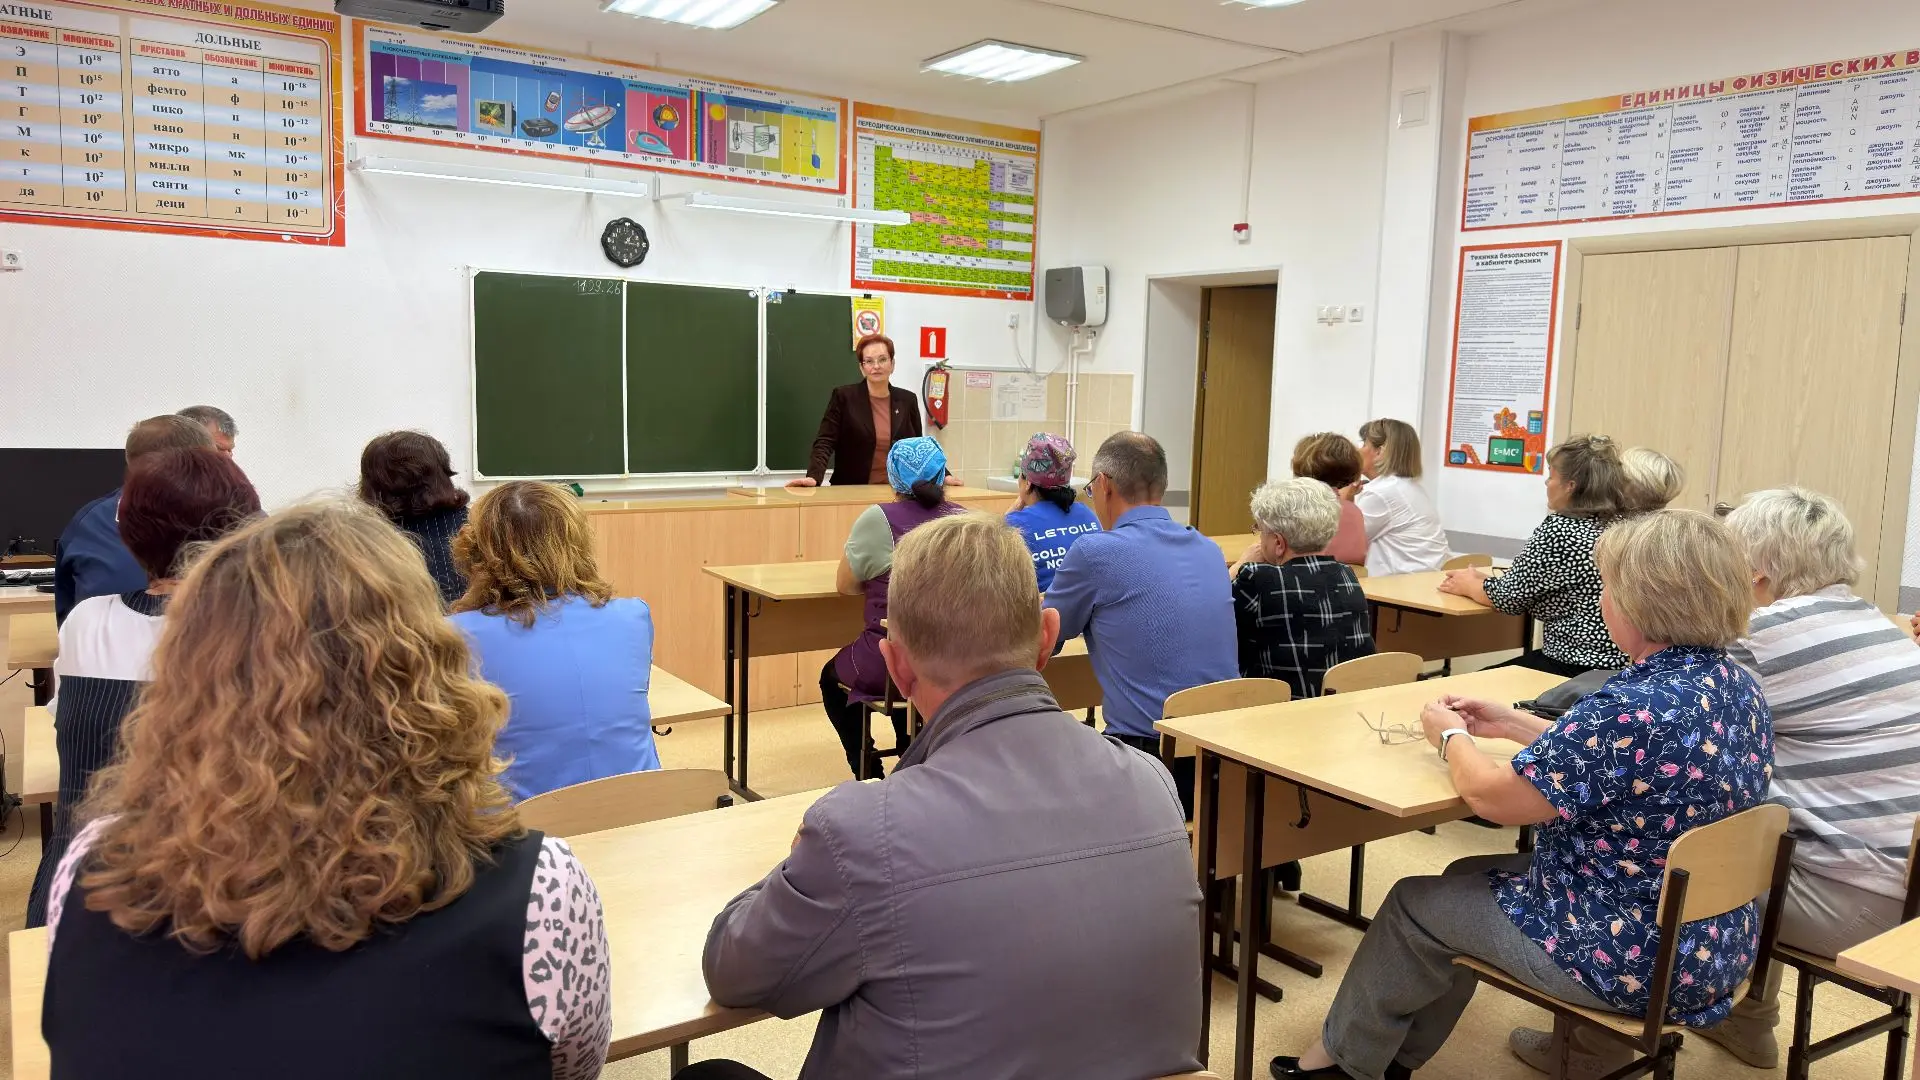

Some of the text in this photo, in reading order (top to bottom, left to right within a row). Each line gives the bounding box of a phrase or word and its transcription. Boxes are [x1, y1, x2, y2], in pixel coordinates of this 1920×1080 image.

[0, 4, 53, 20] АТНЫЕ
[224, 4, 231, 15] И
[235, 6, 290, 25] ДОЛЬНЫХ
[292, 16, 334, 33] ЕДИНИЦ
[0, 25, 50, 39] ОЗНАЧЕНИЕ
[63, 33, 114, 48] МНОЖИТЕЛЬ
[195, 32, 262, 50] ДОЛЬНЫЕ
[16, 46, 26, 57] Э
[204, 54, 258, 68] ОБОЗНАЧЕНИЕ
[15, 66, 27, 77] П
[152, 66, 181, 77] атто
[268, 62, 314, 76] МНОЖИТЕЛЬ
[1621, 81, 1725, 108] ЕДИНИЦЫ
[1732, 53, 1897, 91] ФИЗИЧЕСКИХ
[17, 86, 28, 97] Т
[147, 83, 187, 98] фемто
[1879, 93, 1906, 101] джоуль
[18, 106, 29, 117] Г
[152, 104, 184, 116] пико
[1579, 119, 1623, 129] ПРОИЗВОДНЫЕ
[1625, 114, 1655, 123] ЕДИНИЦЫ
[1736, 116, 1770, 124] килограмм
[17, 126, 32, 138] М
[153, 123, 184, 135] нано
[905, 128, 930, 136] СИСТЕМА
[931, 131, 964, 142] ХИМИЧЕСКИХ
[966, 136, 994, 146] ЭЛЕМЕНТОВ
[1005, 142, 1036, 151] МЕНДЕЛЕЕВА
[1485, 133, 1516, 142] ОСНОВНЫЕ
[1516, 130, 1544, 138] ЕДИНИЦЫ
[1794, 132, 1832, 140] количество
[149, 142, 190, 155] микро
[1733, 139, 1767, 147] килограмм
[21, 148, 30, 157] к
[22, 168, 29, 176] г
[149, 160, 191, 172] милли
[1792, 165, 1822, 173] удельная
[152, 180, 189, 191] санти
[1790, 183, 1820, 191] удельная
[1864, 182, 1901, 190] килограмм
[19, 187, 35, 198] да
[155, 198, 186, 210] деци
[1499, 251, 1549, 259] безопасности
[1034, 522, 1098, 541] LETOILE
[1031, 547, 1067, 561] COLD
